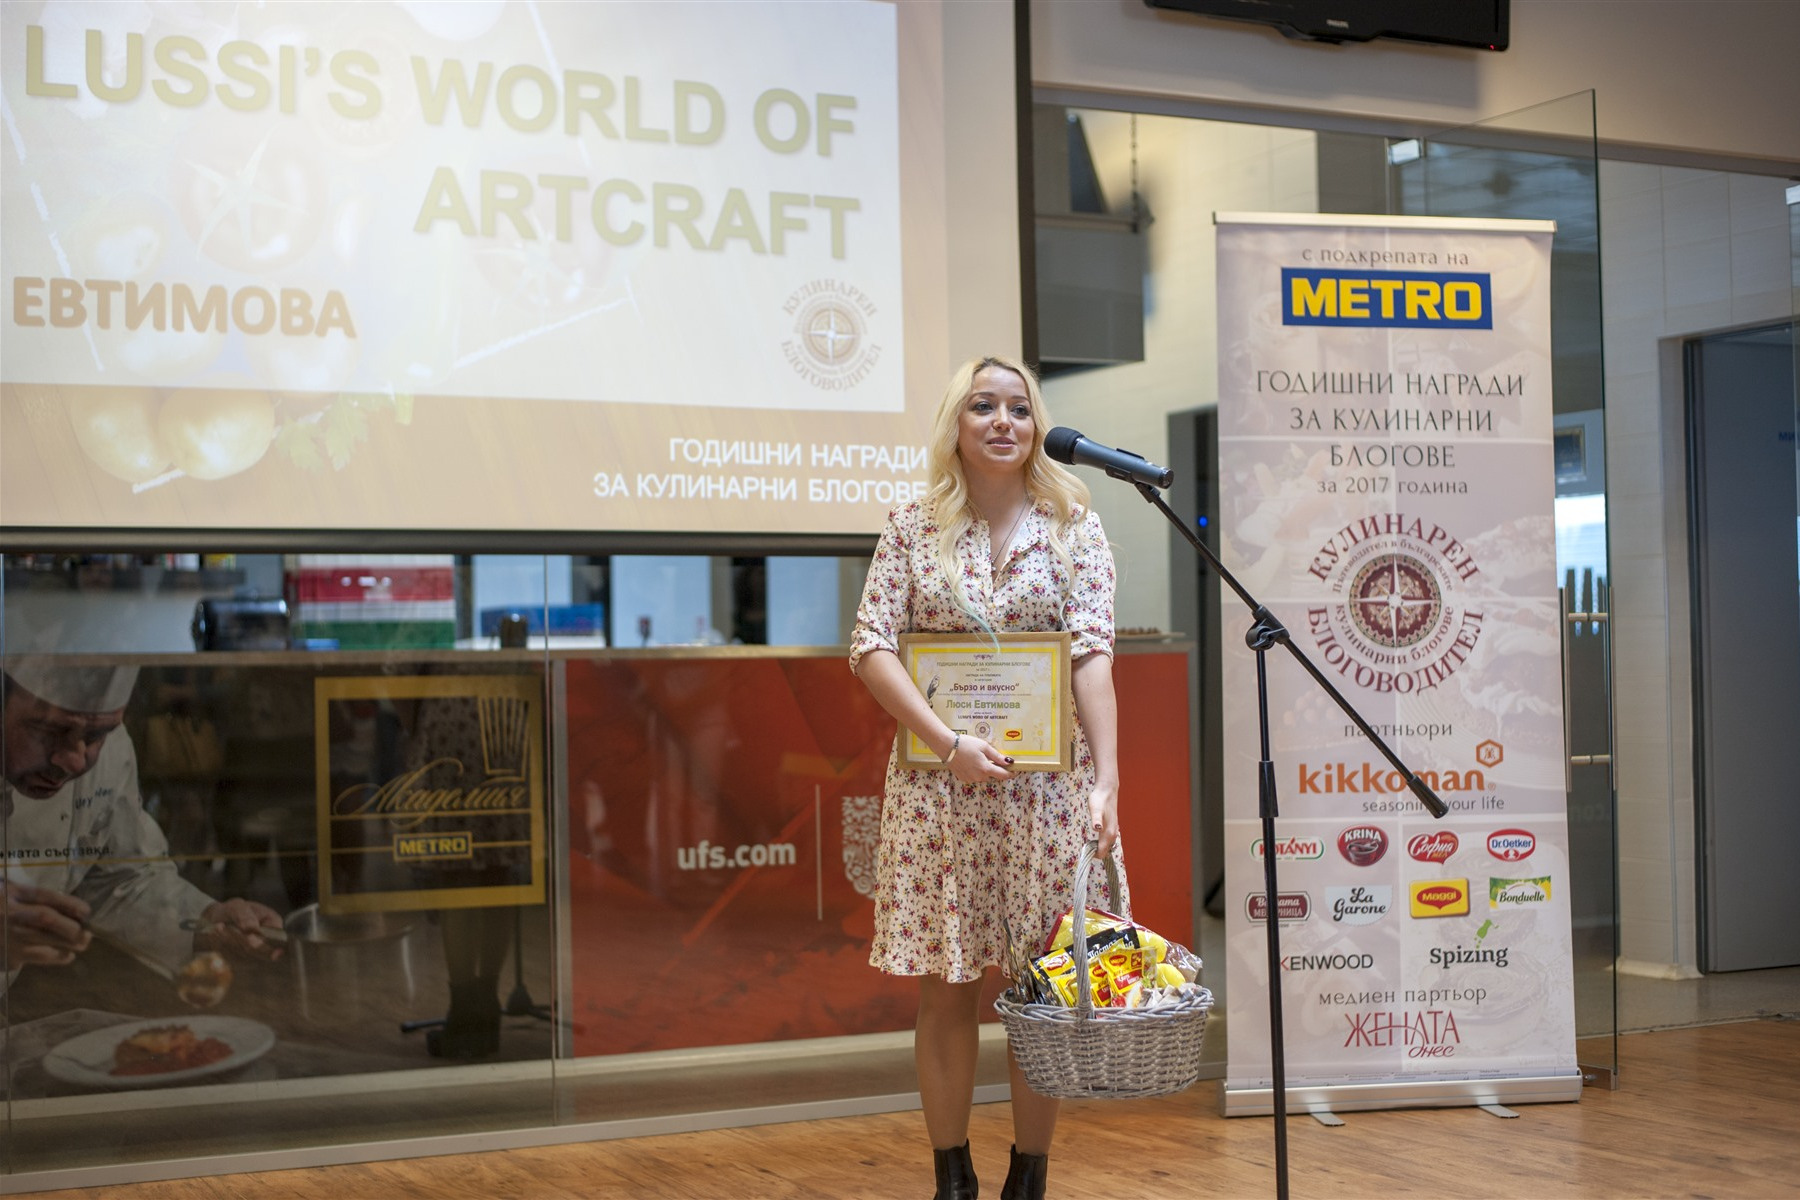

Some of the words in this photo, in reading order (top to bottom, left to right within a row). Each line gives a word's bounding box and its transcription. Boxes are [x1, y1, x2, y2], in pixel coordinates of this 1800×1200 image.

[410, 55, 727, 146] WORLD
[753, 87, 858, 157] OF
[413, 166, 863, 260] ARTCRAFT
[1302, 249, 1312, 261] с
[1320, 250, 1439, 267] подкрепата
[1447, 252, 1469, 265] на
[12, 276, 358, 339] ЕВТИМОВА
[1291, 277, 1483, 321] METRO
[1257, 370, 1393, 395] ГОДИШНИ
[1406, 372, 1524, 397] НАГРАДИ
[1290, 408, 1321, 431] ЗА
[1334, 408, 1493, 432] КУЛИНАРНИ
[669, 438, 802, 468] ГОДИШНИ
[811, 444, 928, 474] НАГРАДИ
[1330, 445, 1456, 468] БЛОГОВЕ
[594, 472, 629, 498] ЗА
[637, 473, 797, 501] КУЛИНАРНИ
[808, 479, 928, 504] БЛОГОВЕ
[1317, 480, 1337, 493] за
[1345, 477, 1389, 493] 2017
[1398, 479, 1469, 495] година
[1307, 513, 1480, 582] КУЛИНАРЕН
[1336, 603, 1407, 665] кулинарни
[1411, 605, 1455, 660] блогове
[1307, 605, 1484, 696] БЛОГОВОДИТЕЛ
[946, 700, 972, 709] Люси
[974, 700, 1020, 709] Евтимова
[1481, 796, 1505, 811] life
[400, 837, 467, 855] METRO
[1344, 829, 1382, 843] KRINA
[677, 840, 797, 870] ufs.com
[1350, 887, 1374, 903] La
[1499, 891, 1545, 905] Bonduelle
[1333, 898, 1387, 922] Garone
[1429, 945, 1509, 968] Spizing
[1319, 990, 1396, 1006] медиен
[1404, 986, 1487, 1006] партьор
[1344, 1011, 1461, 1048] ЖЕНАТА
